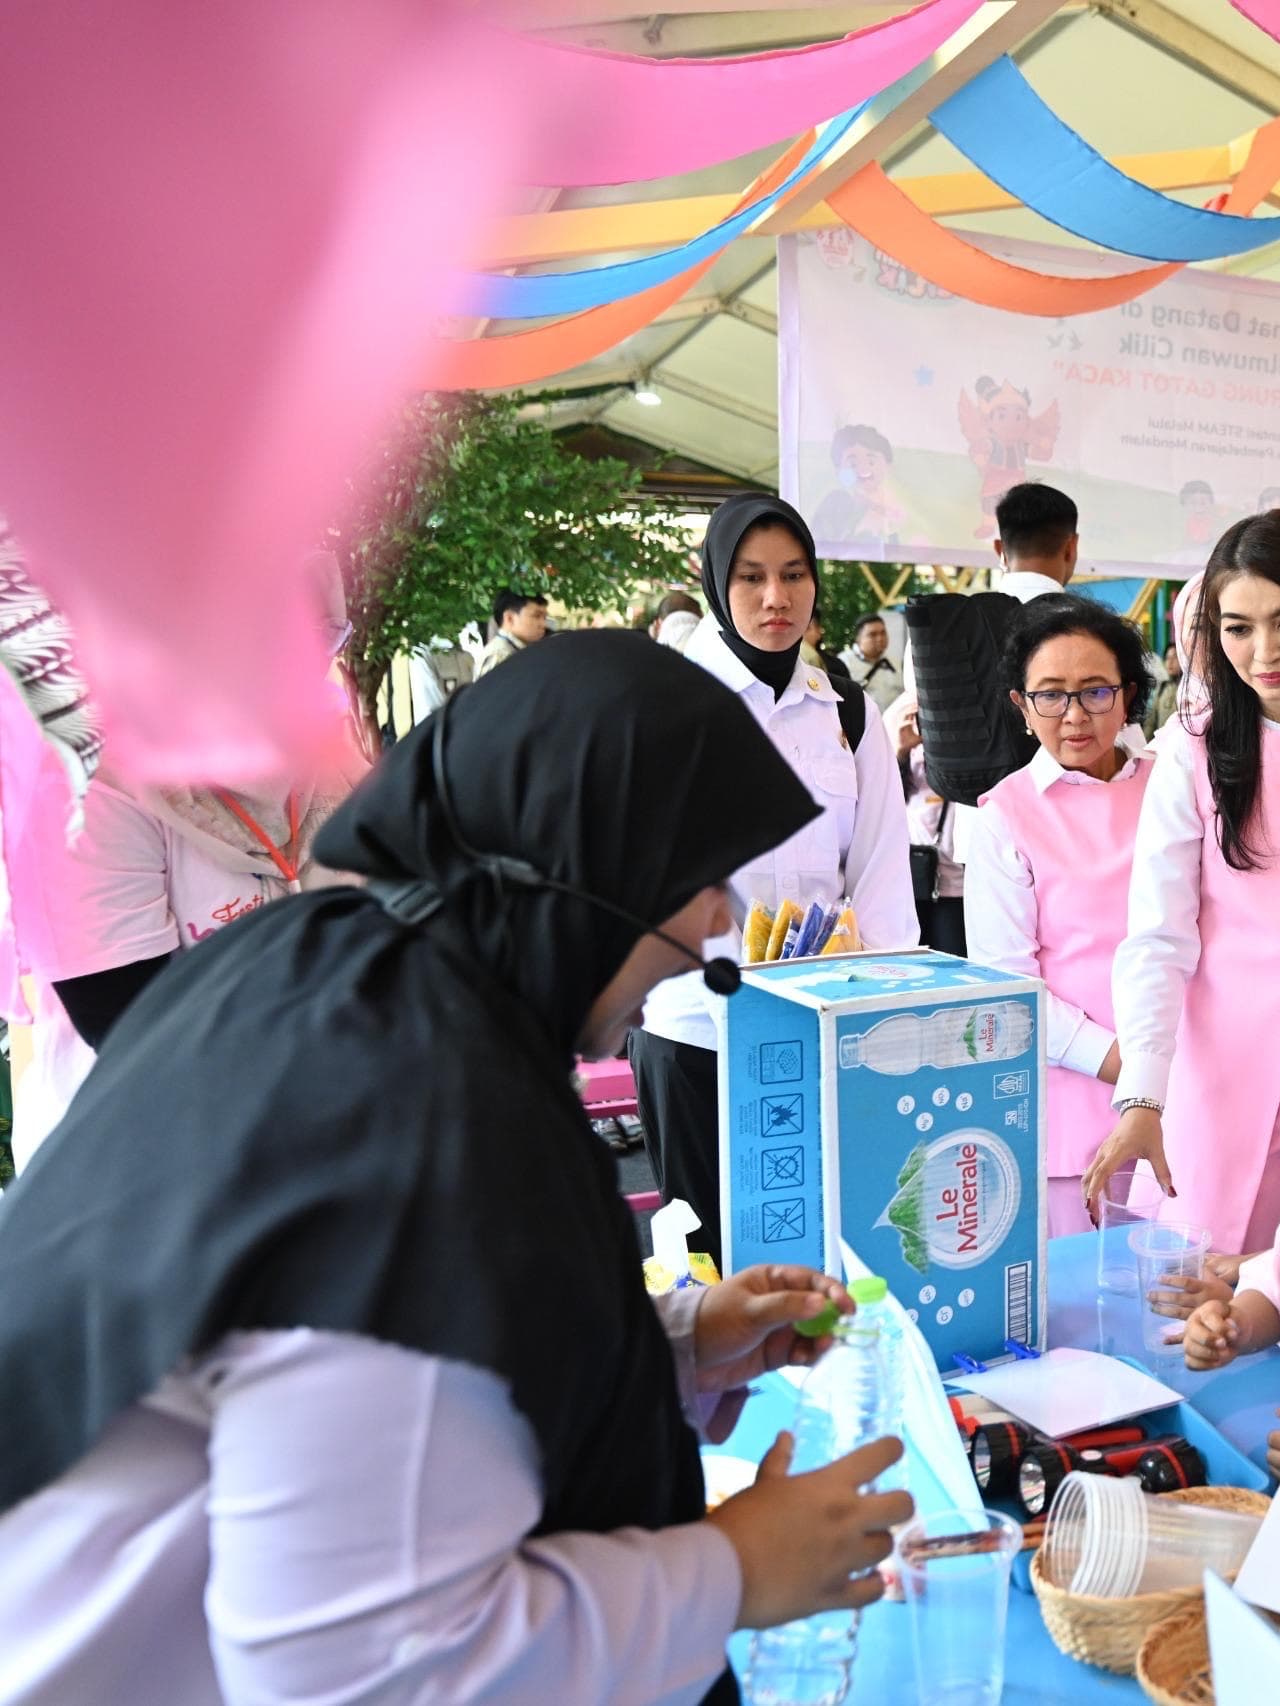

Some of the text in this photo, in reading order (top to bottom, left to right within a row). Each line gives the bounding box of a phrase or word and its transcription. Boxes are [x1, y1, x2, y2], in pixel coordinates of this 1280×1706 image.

[986, 1013, 995, 1052] Minerale
[936, 1189, 958, 1222] Le
[956, 1143, 979, 1253] Minerale
